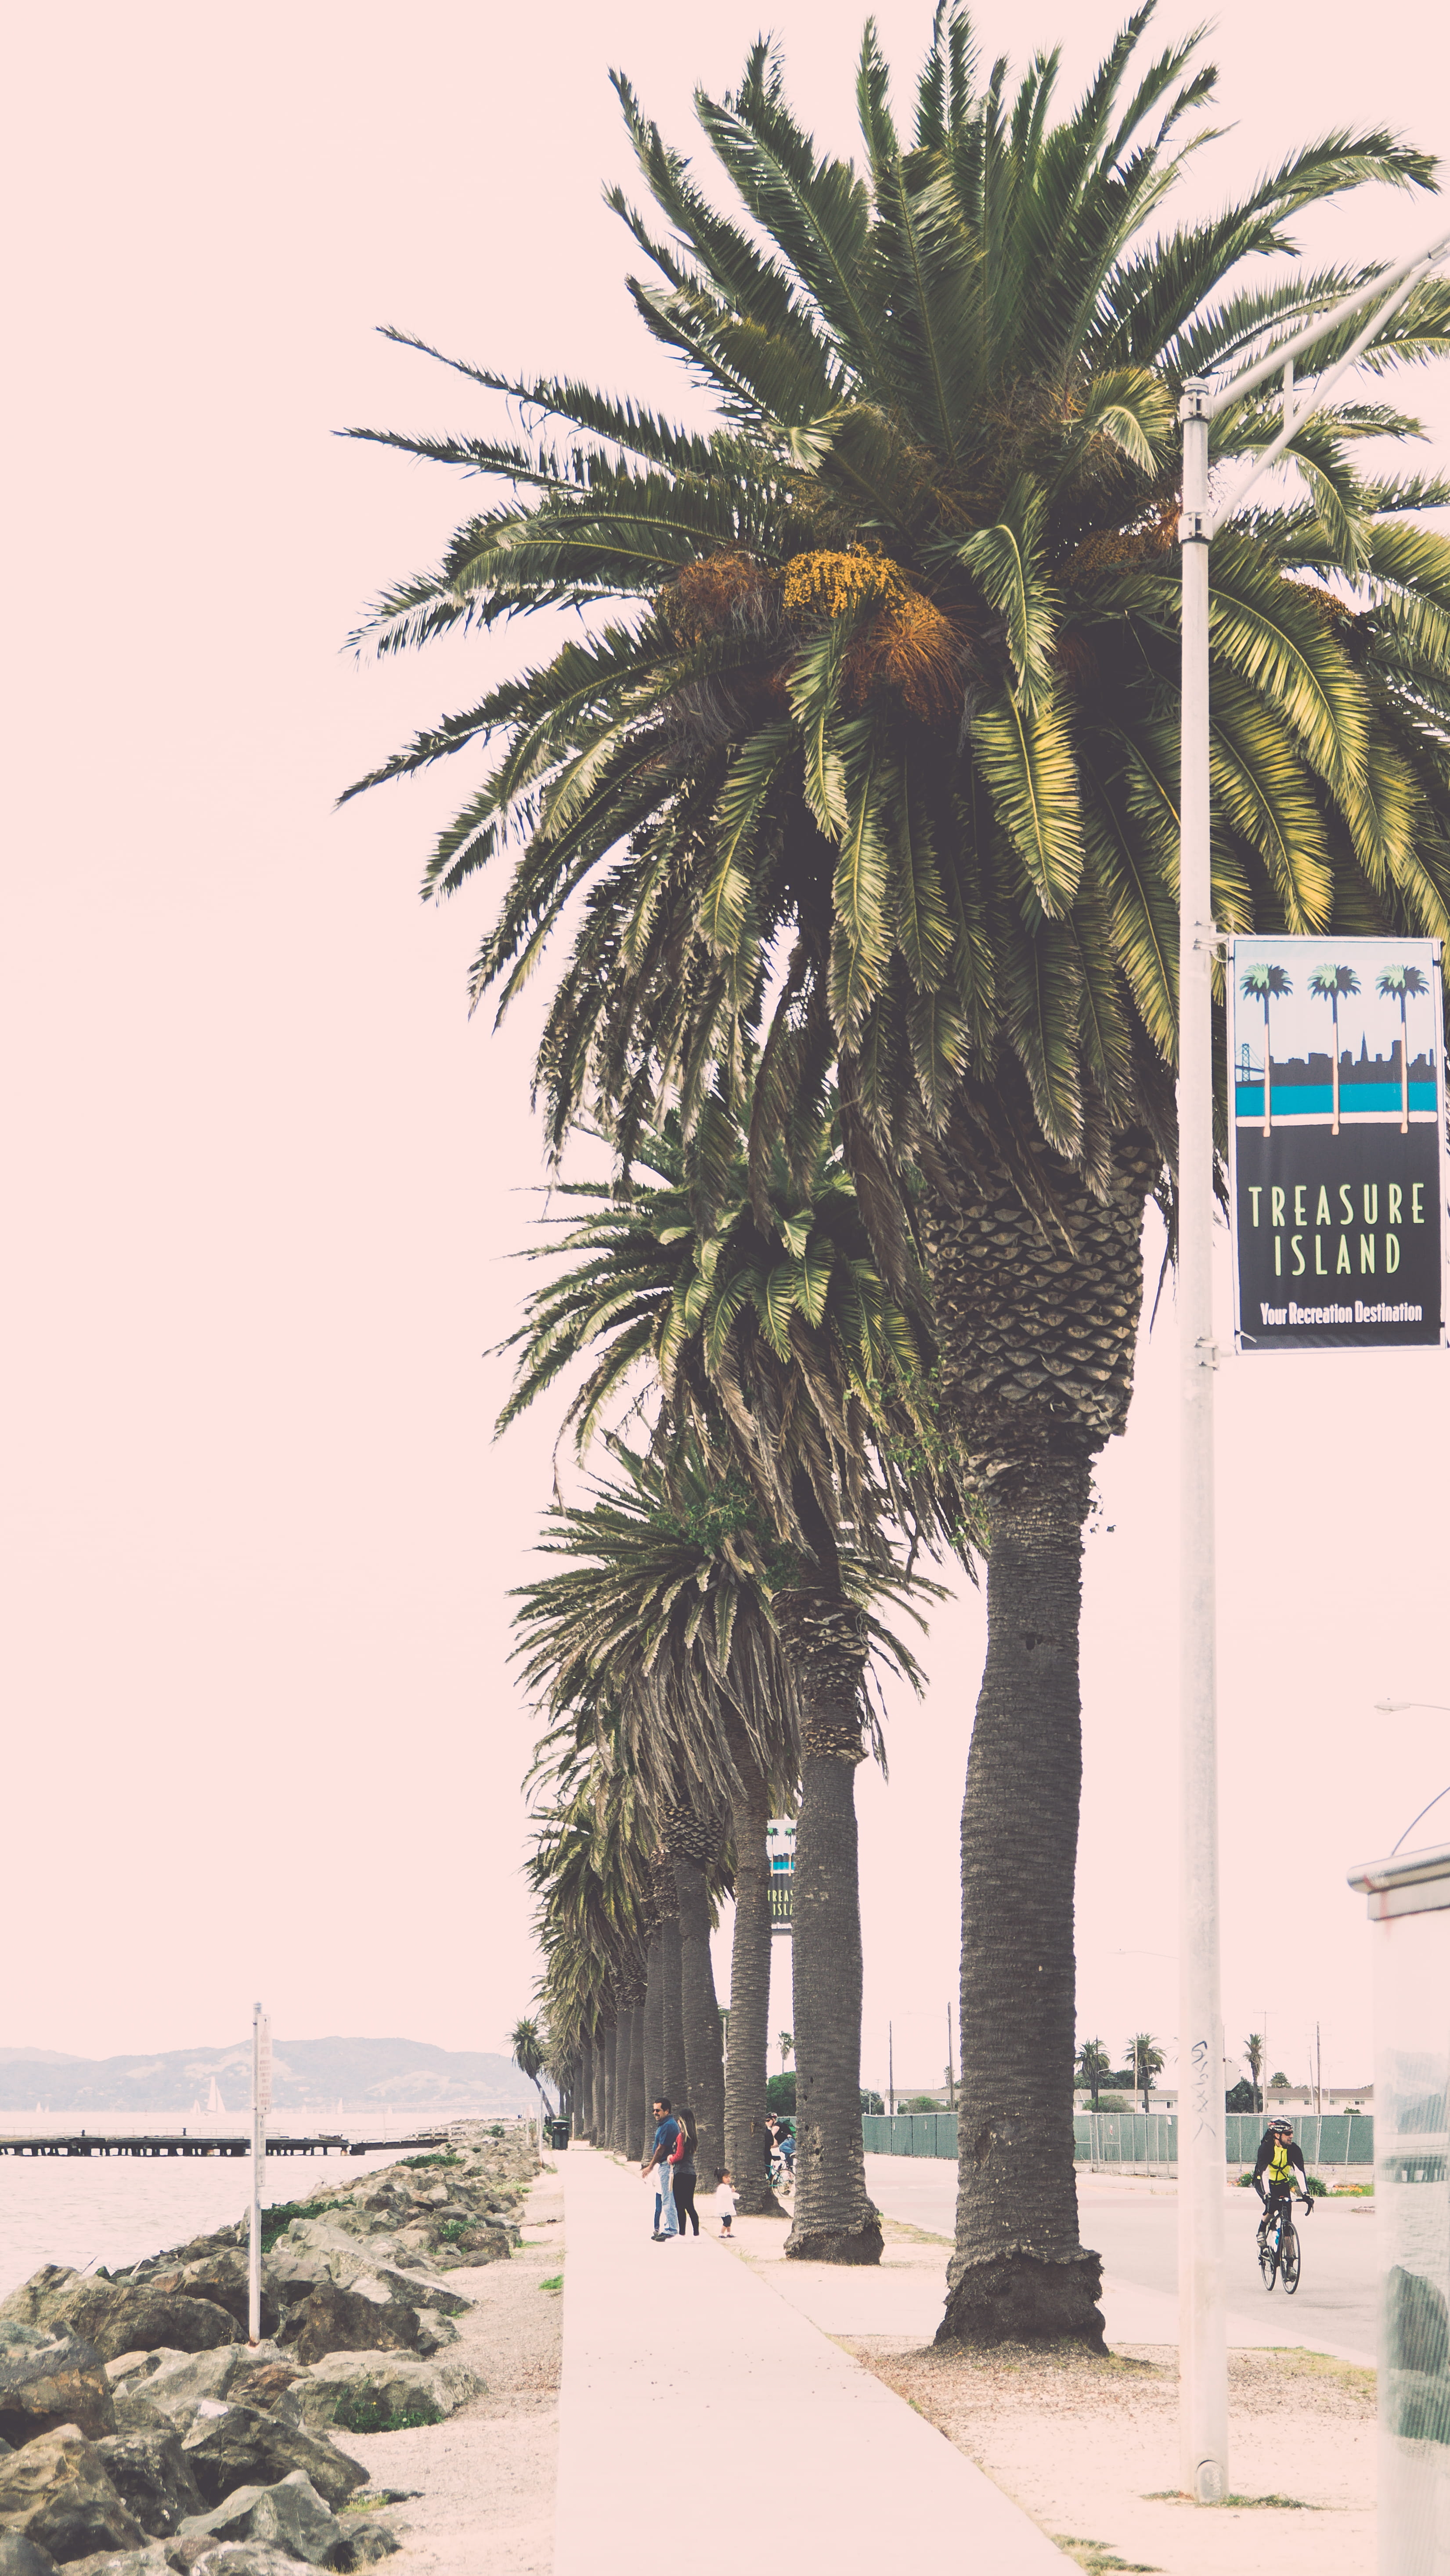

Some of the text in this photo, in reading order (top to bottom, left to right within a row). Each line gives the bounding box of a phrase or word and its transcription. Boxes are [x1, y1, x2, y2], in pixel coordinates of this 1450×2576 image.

[1248, 1183, 1425, 1227] TREASURE
[1275, 1233, 1400, 1276] ISLAND
[1260, 1300, 1422, 1325] Your Recreation Destination
